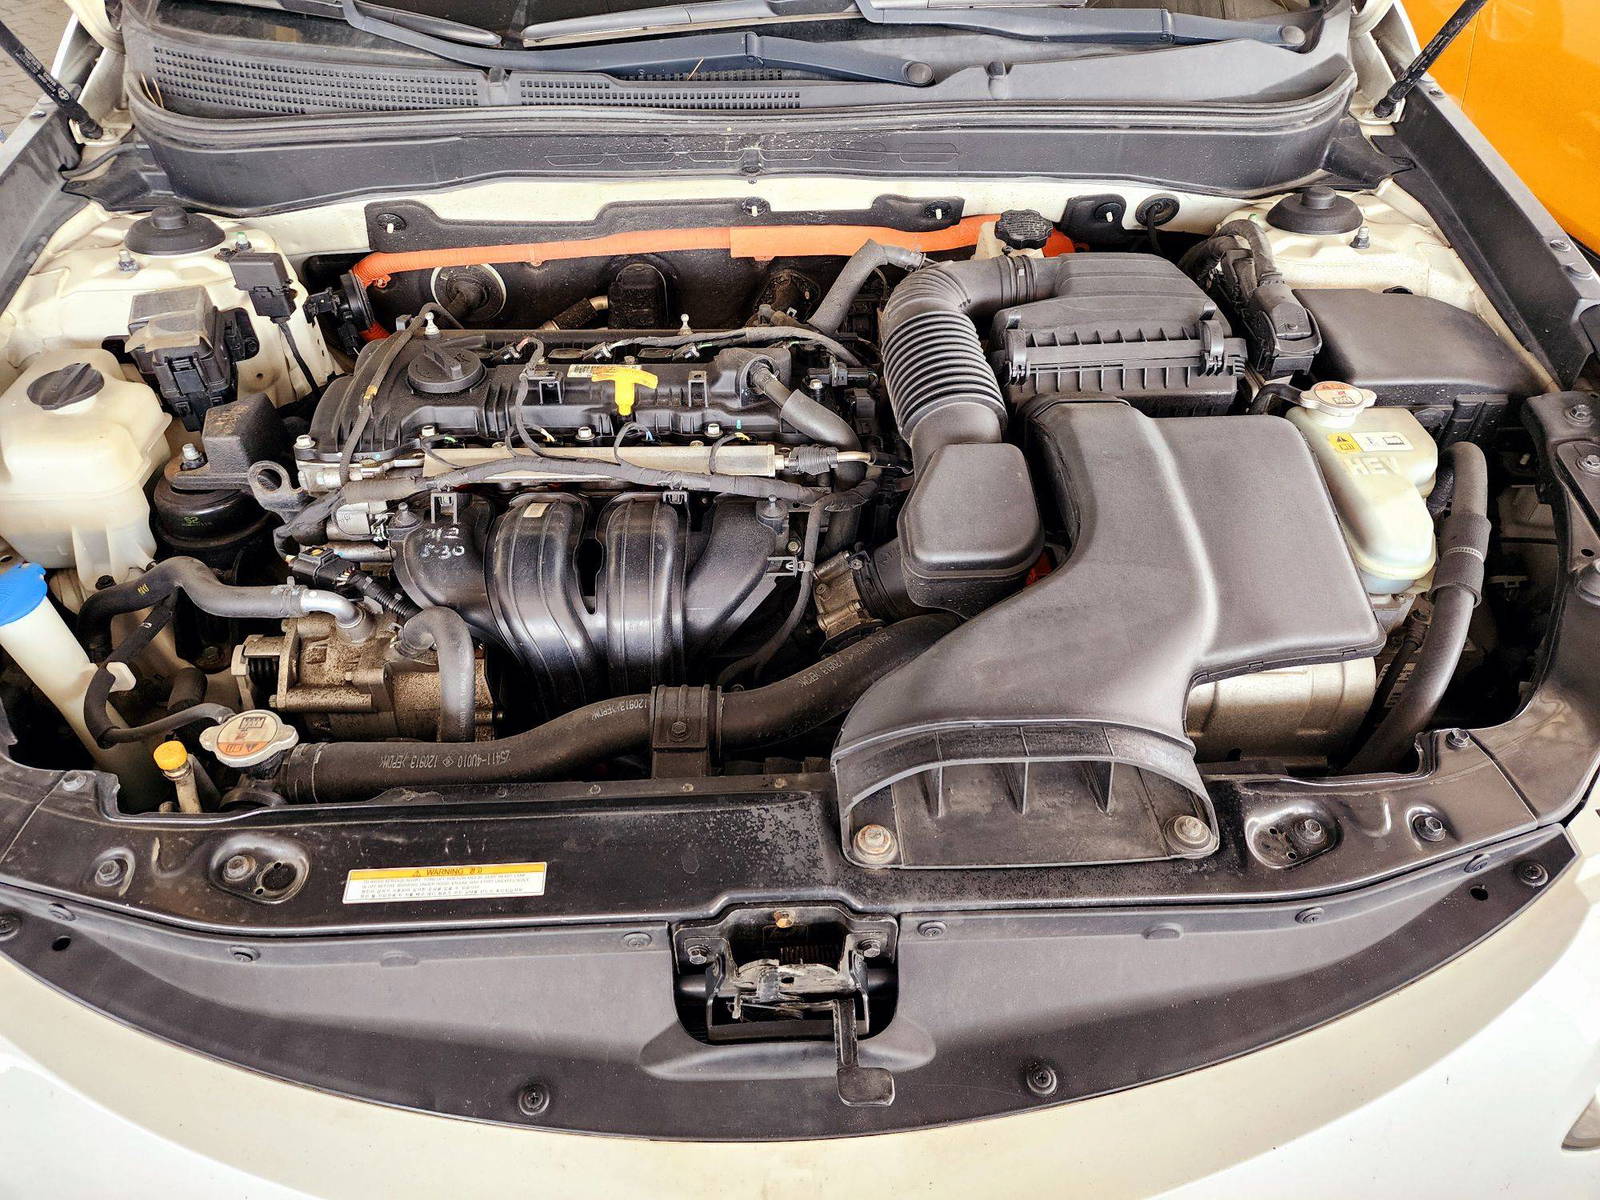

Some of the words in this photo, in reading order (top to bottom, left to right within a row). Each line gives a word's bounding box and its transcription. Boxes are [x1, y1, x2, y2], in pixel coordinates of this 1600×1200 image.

[1344, 456, 1401, 475] HEV
[410, 754, 438, 769] 120913
[426, 867, 464, 877] WARNING
